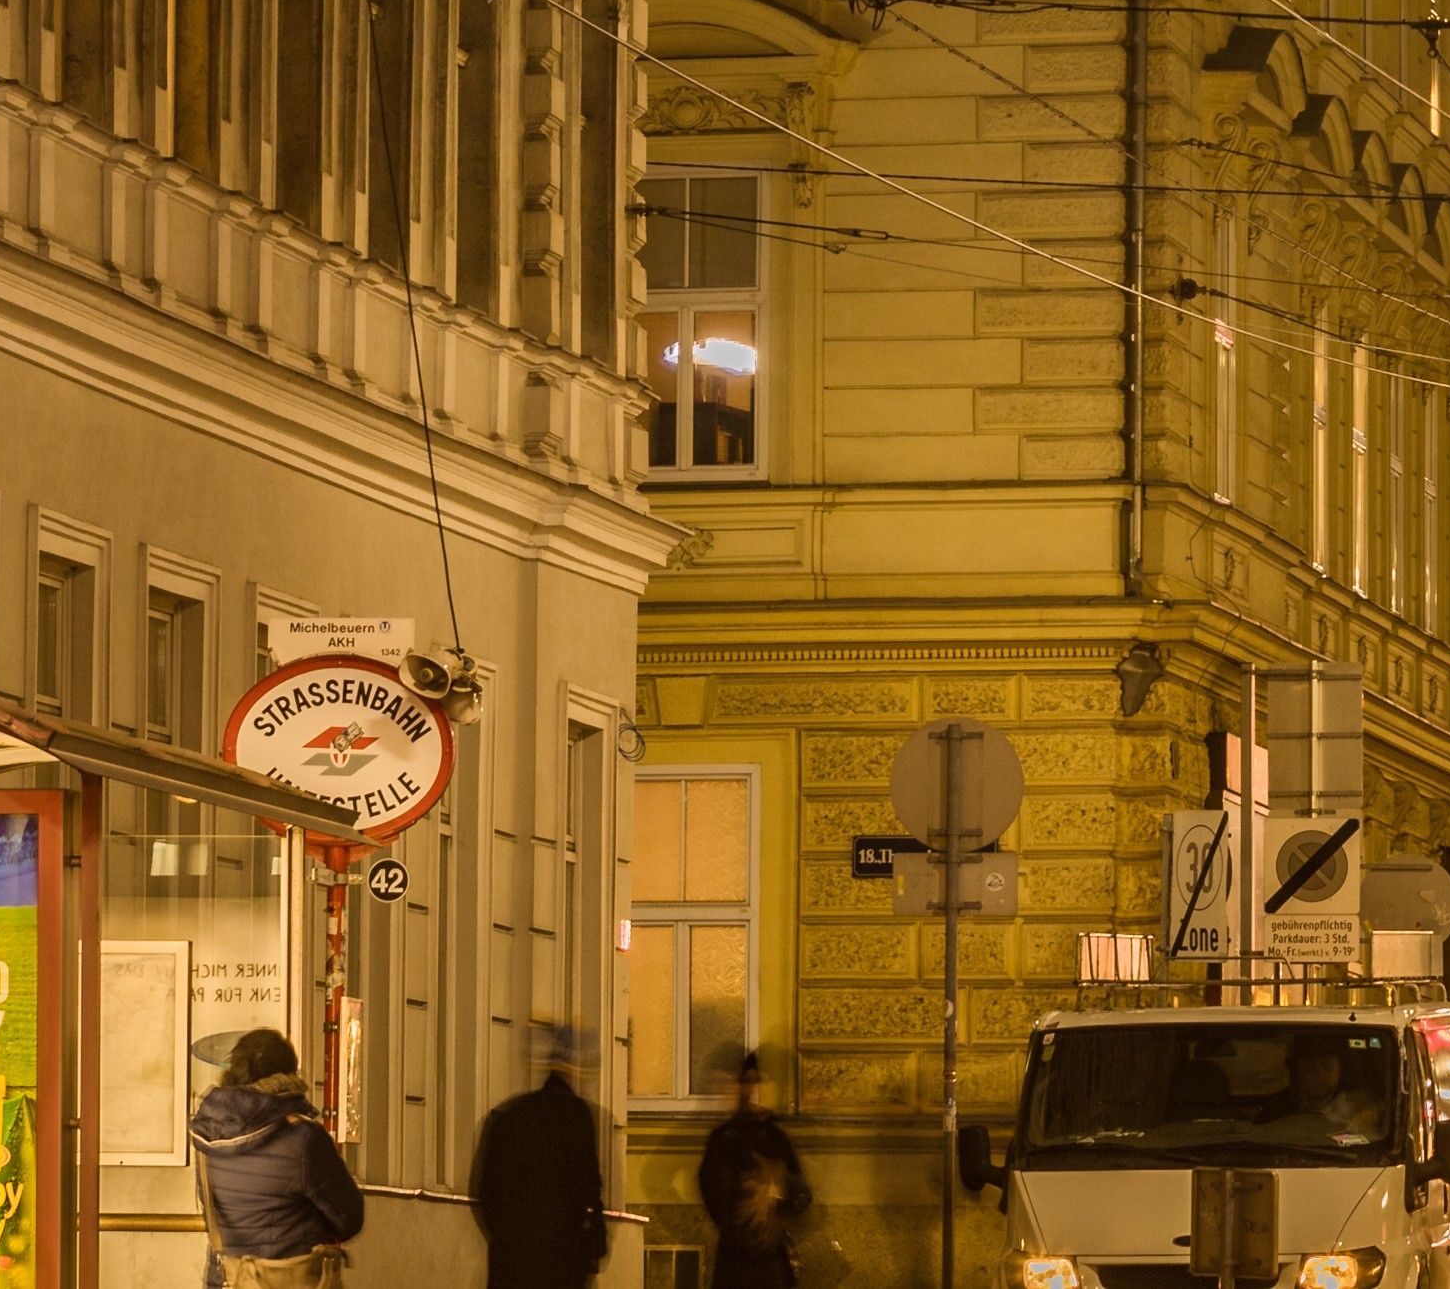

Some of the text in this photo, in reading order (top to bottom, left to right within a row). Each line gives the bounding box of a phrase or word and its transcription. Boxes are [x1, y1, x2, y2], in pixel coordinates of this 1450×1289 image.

[289, 621, 376, 633] Michelbeuern
[327, 637, 356, 648] AKH
[380, 648, 400, 657] 1342
[253, 679, 432, 744] STRASSENBAHN
[1184, 841, 1214, 894] 30
[370, 867, 404, 894] 42
[1271, 920, 1353, 932] gebührenpflichtig
[1272, 933, 1350, 944] Parkdauer: 3 Std.
